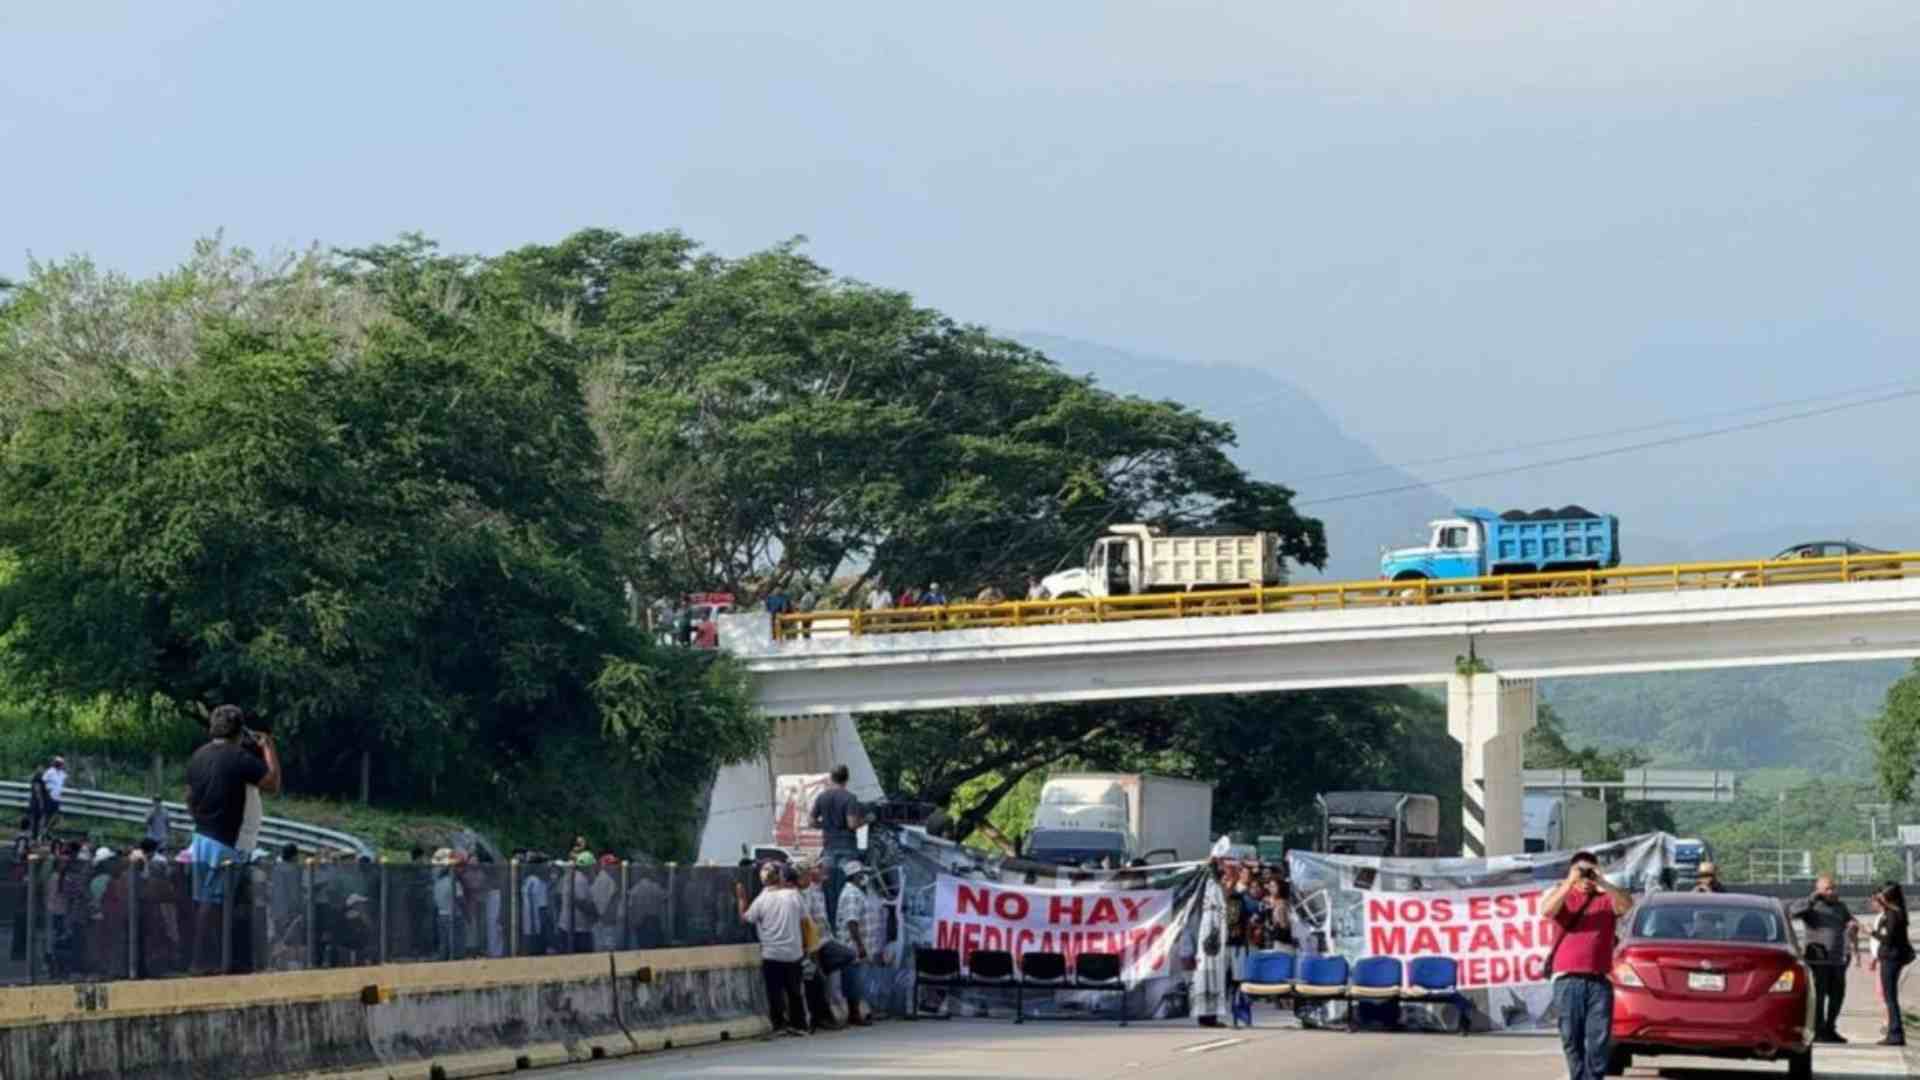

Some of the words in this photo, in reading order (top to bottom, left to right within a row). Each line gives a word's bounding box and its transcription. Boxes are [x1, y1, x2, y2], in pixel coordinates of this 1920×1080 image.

[957, 884, 1029, 920] NO
[1049, 895, 1151, 925] HAY
[1369, 899, 1454, 923] NOS
[1468, 890, 1543, 920] EST
[1370, 920, 1560, 955] MATAND
[1457, 954, 1544, 985] EDIC
